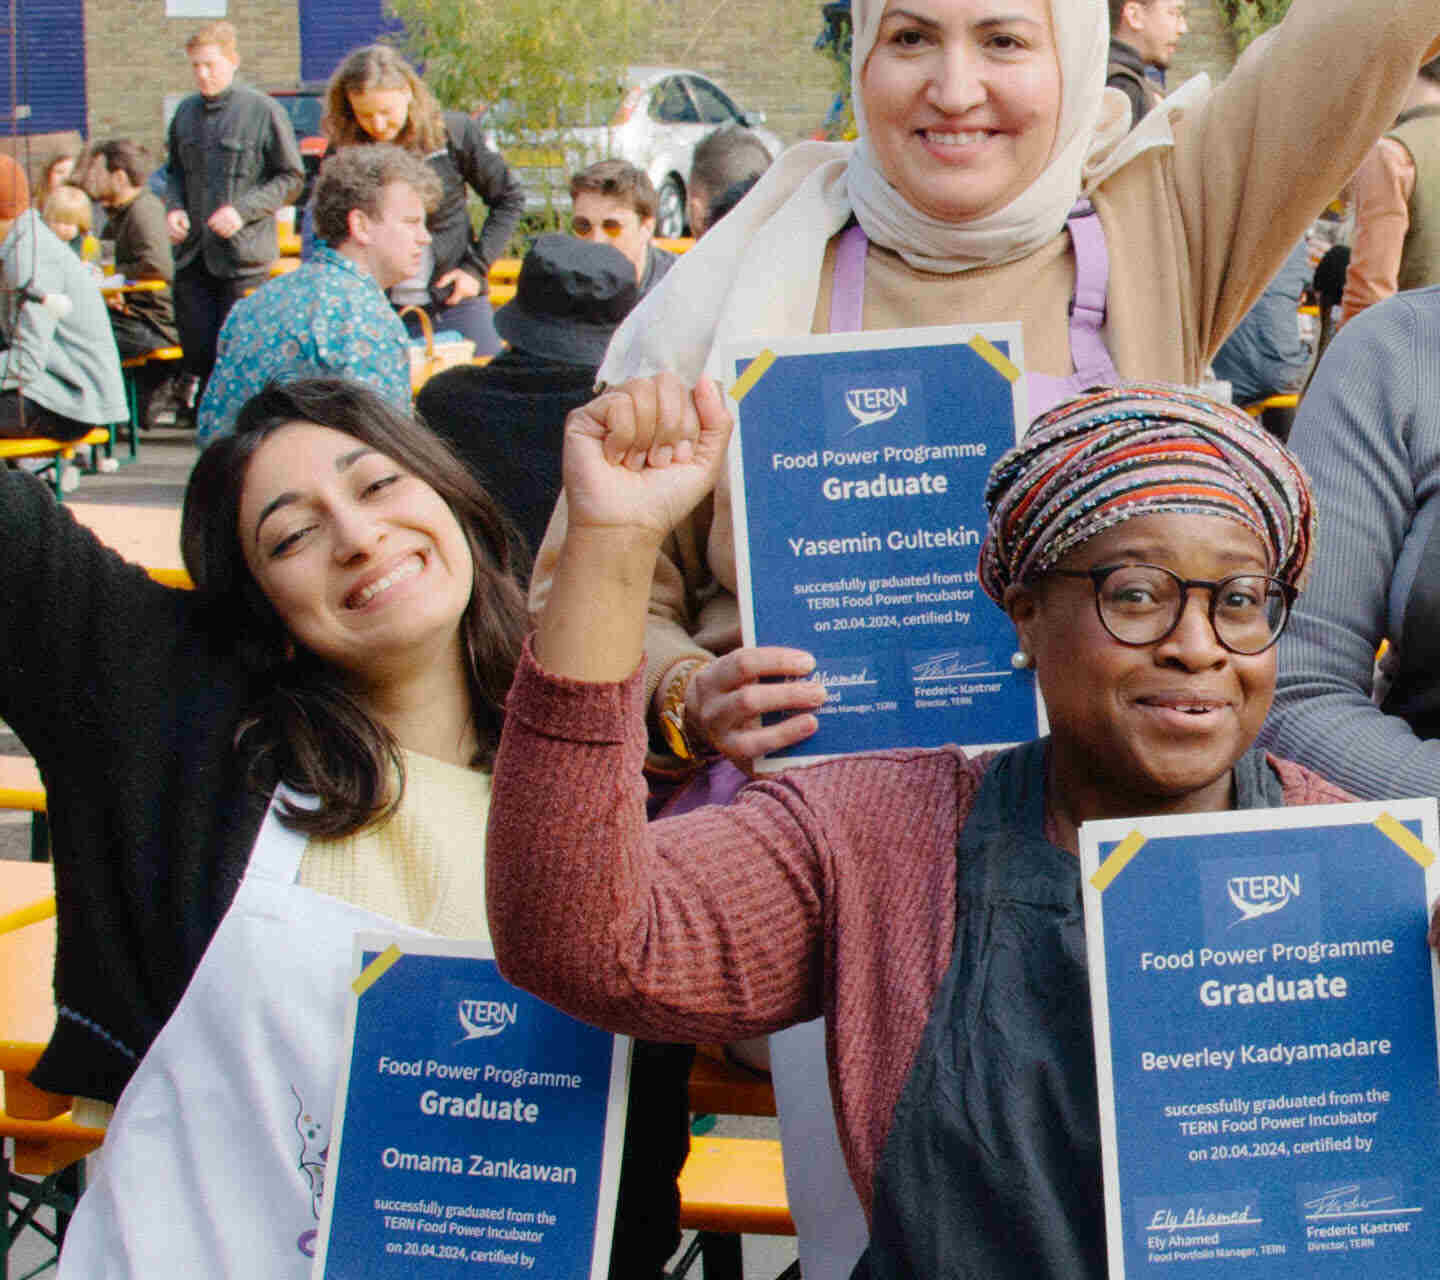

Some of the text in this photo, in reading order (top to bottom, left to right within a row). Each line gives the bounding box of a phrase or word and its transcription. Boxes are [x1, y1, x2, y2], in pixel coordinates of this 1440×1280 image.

[851, 387, 908, 410] TERN
[771, 442, 986, 470] Food Power Programme
[821, 473, 947, 500] Graduate
[787, 531, 881, 556] Yasemin
[793, 570, 977, 594] successfully graduated from th
[806, 589, 974, 610] TERN Food Power Incubator
[813, 621, 831, 631] on
[901, 610, 953, 626] certified
[954, 610, 970, 624] by
[1233, 874, 1300, 900] TERN
[1140, 938, 1394, 970] Food Power Programme
[1199, 973, 1348, 1007] Graduate
[462, 999, 518, 1025] TERN
[1141, 1037, 1392, 1071] Beverley Kadyamadare
[377, 1055, 581, 1088] Food Power Programme
[418, 1089, 538, 1123] Graduate
[1163, 1087, 1391, 1117] successfully graduated from the
[1179, 1111, 1378, 1136] TERN Food Power Incubator
[1187, 1149, 1208, 1162] on
[1292, 1136, 1352, 1154] certified
[1354, 1135, 1372, 1151] by
[380, 1147, 576, 1184] Omama Zankawan
[373, 1199, 556, 1225] successfully graduated from the
[383, 1215, 544, 1243] TERN Food Power Incubator
[383, 1242, 402, 1254] on
[468, 1247, 519, 1266] certified
[519, 1252, 535, 1268] by
